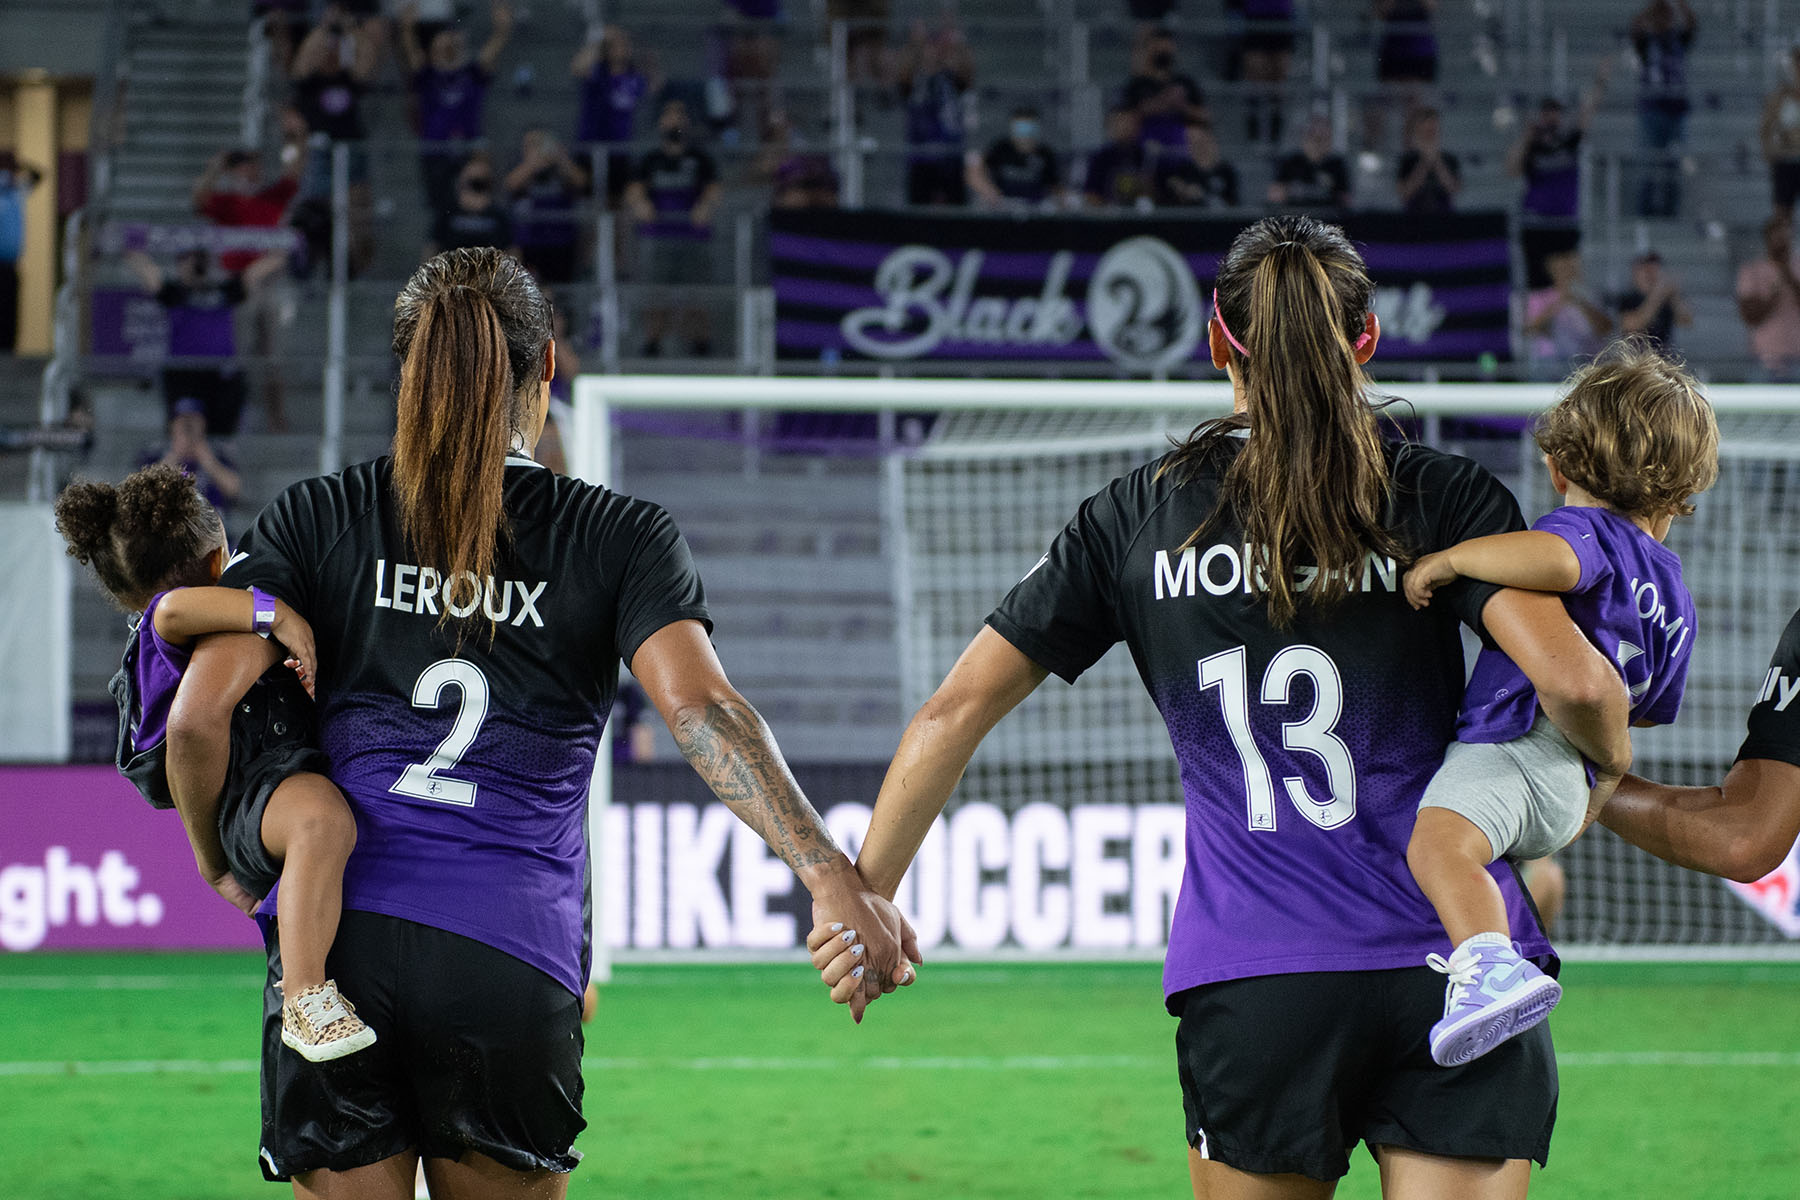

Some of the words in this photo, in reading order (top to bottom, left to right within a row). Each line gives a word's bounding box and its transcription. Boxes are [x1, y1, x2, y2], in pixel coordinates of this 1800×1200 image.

[841, 245, 1086, 359] Black
[374, 559, 548, 628] LEROUX
[388, 658, 490, 808] 2
[1198, 644, 1357, 832] 13
[0, 845, 164, 951] ght.
